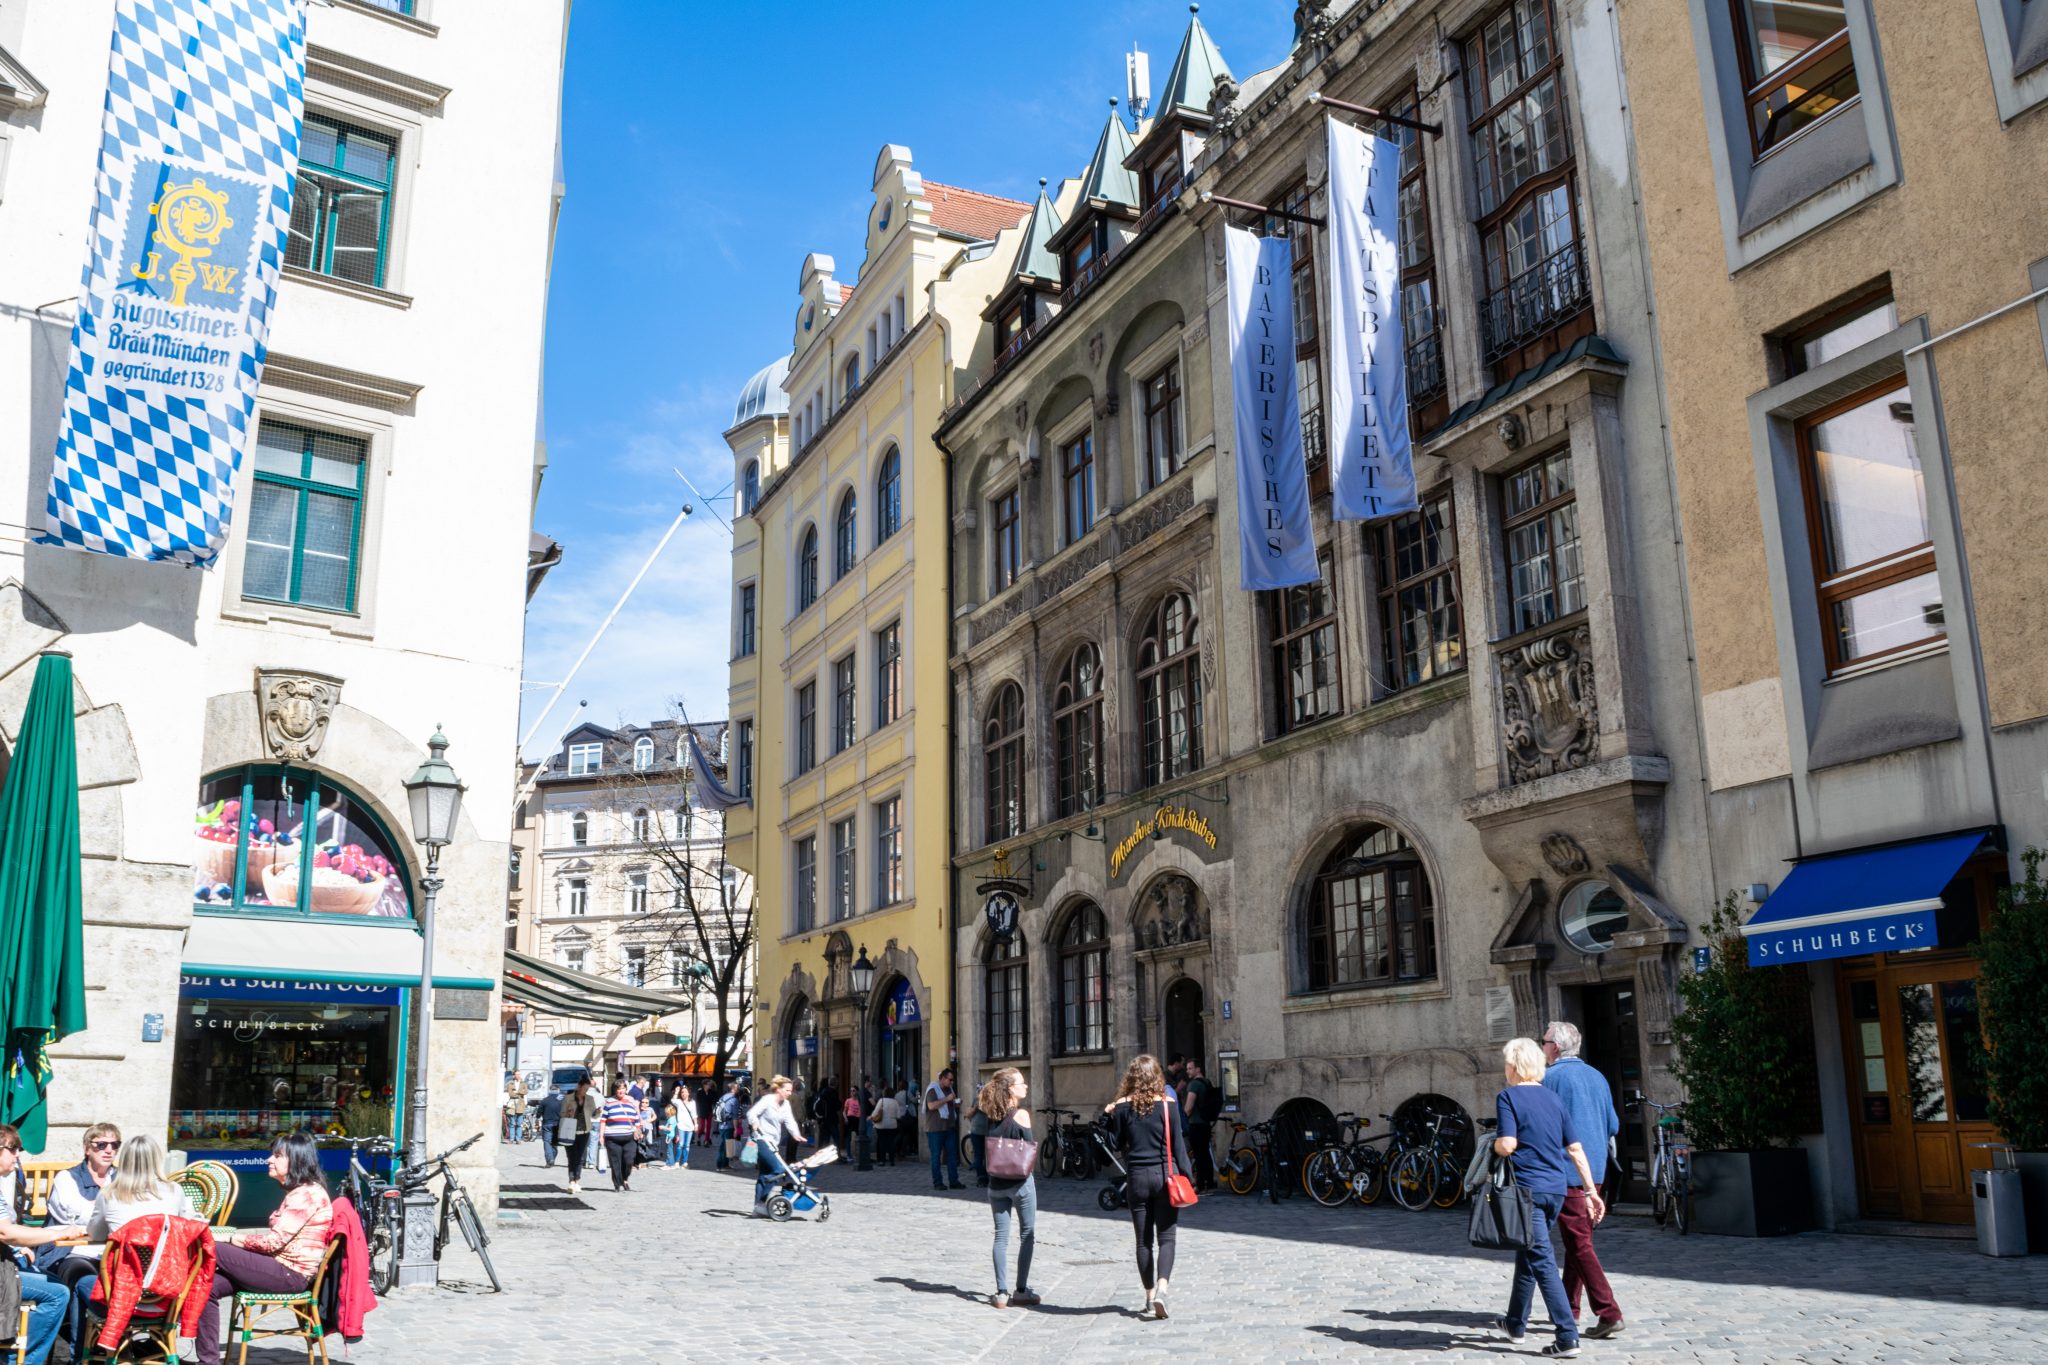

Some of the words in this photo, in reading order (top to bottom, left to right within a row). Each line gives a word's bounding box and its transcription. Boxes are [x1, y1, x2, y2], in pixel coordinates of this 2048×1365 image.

[108, 323, 150, 355] Bräu
[151, 332, 231, 368] München
[1359, 138, 1382, 515] STAATSBALLETT
[103, 360, 189, 387] gegründet
[190, 370, 226, 393] 1328
[1256, 264, 1284, 559] BAYERISCHES
[903, 999, 915, 1016] EIS
